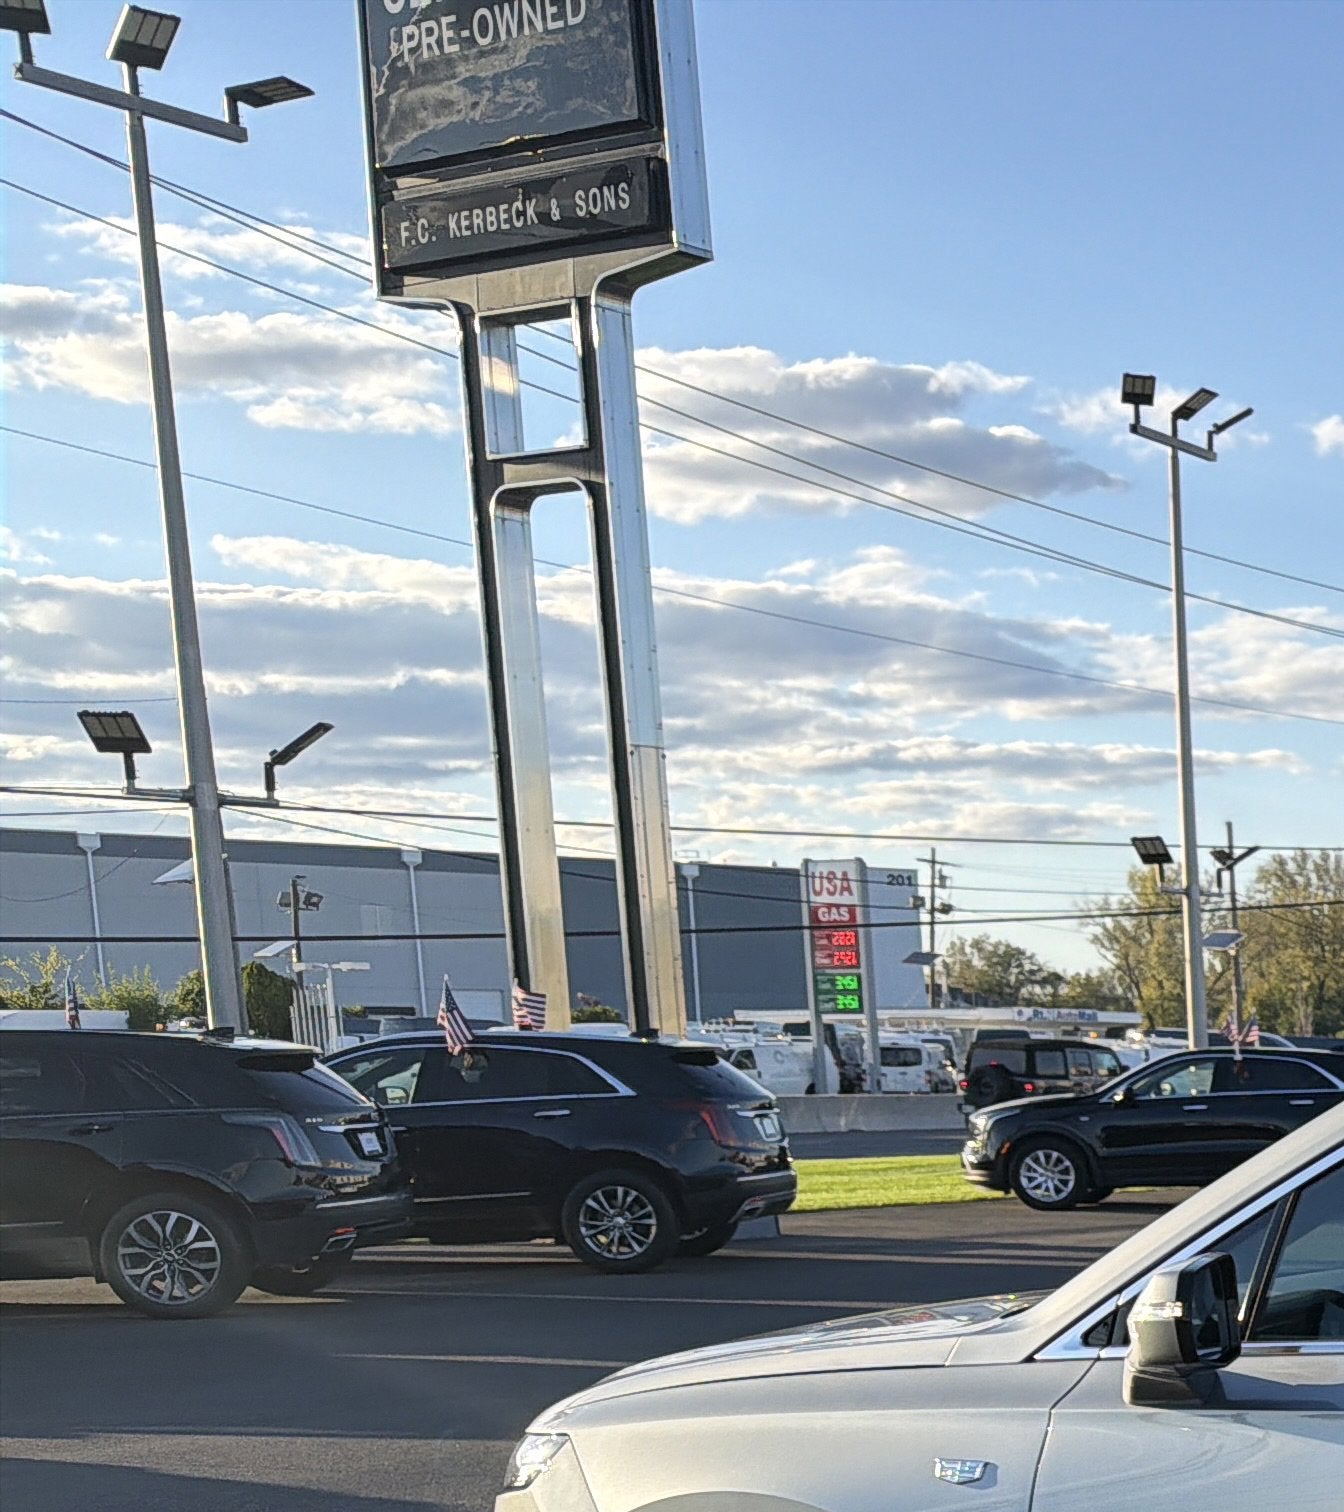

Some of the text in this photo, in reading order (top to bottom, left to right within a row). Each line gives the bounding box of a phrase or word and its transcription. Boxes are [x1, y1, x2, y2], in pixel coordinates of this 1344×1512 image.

[401, 0, 587, 62] PRE-OWNED
[400, 182, 630, 248] F.C. KERBECK & SONS
[811, 870, 853, 897] USA
[886, 874, 913, 887] 201
[817, 907, 850, 922] GAS
